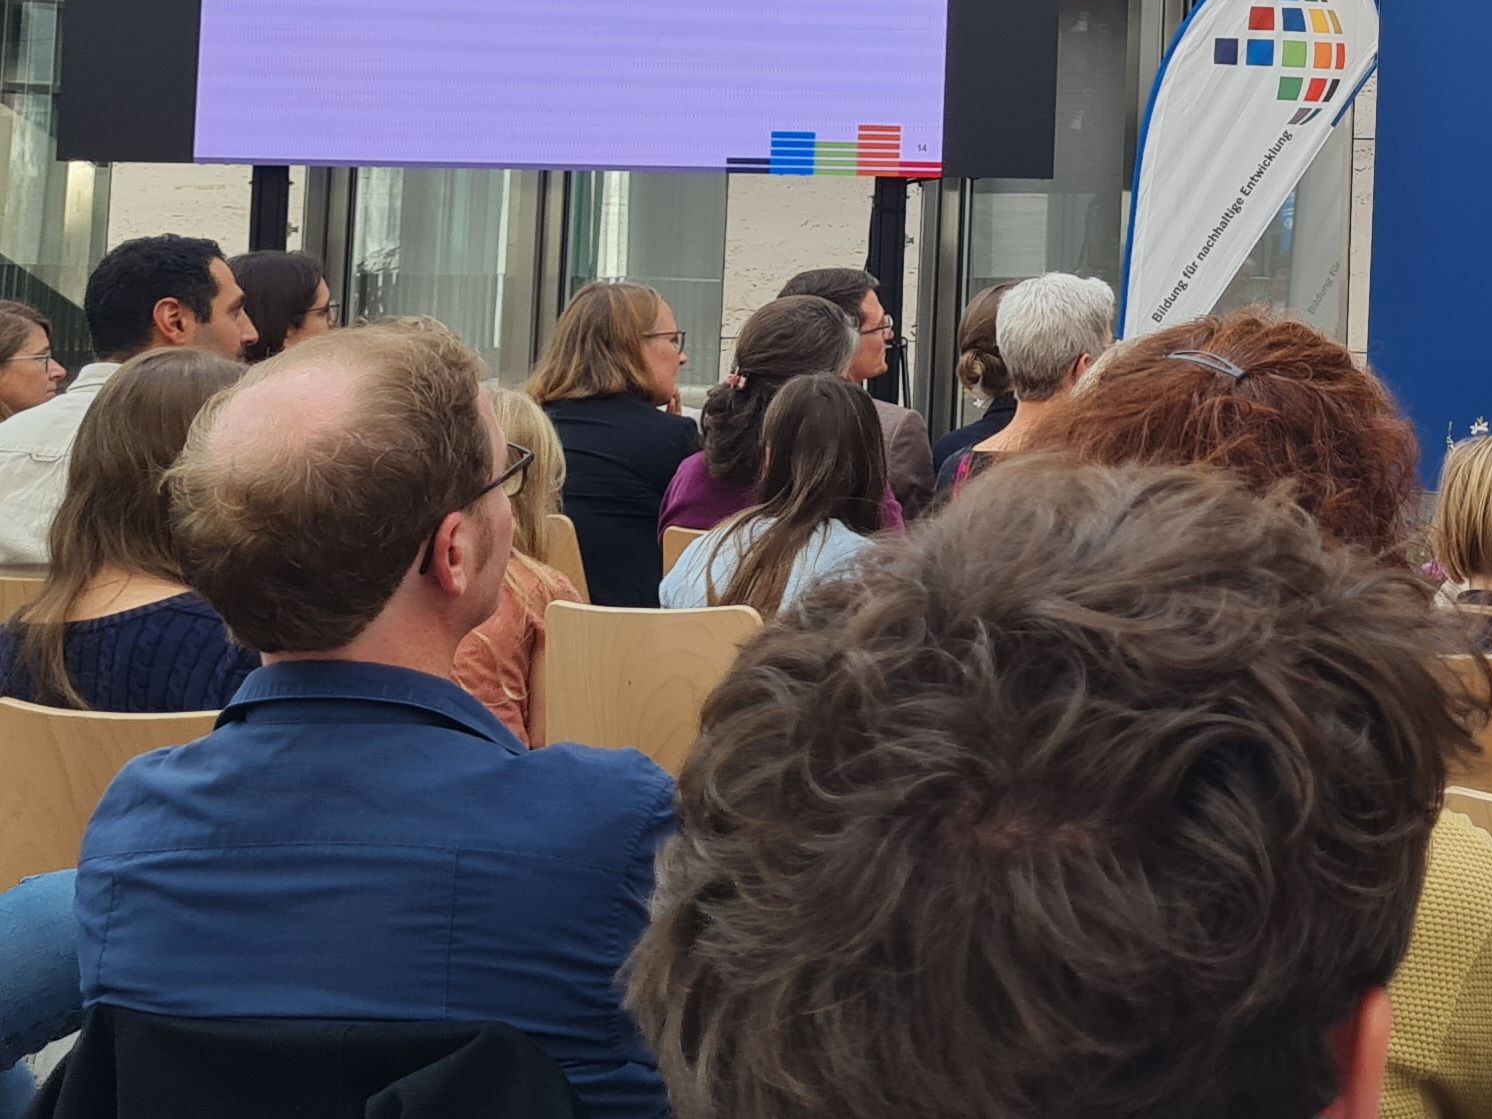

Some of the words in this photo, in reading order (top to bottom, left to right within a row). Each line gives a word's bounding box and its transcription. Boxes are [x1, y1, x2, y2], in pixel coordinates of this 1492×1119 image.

[917, 143, 928, 152] 14
[1151, 279, 1189, 324] Bildung
[1182, 260, 1199, 280] für
[1196, 196, 1245, 262] nachhaltige
[1239, 129, 1294, 198] Entwicklung
